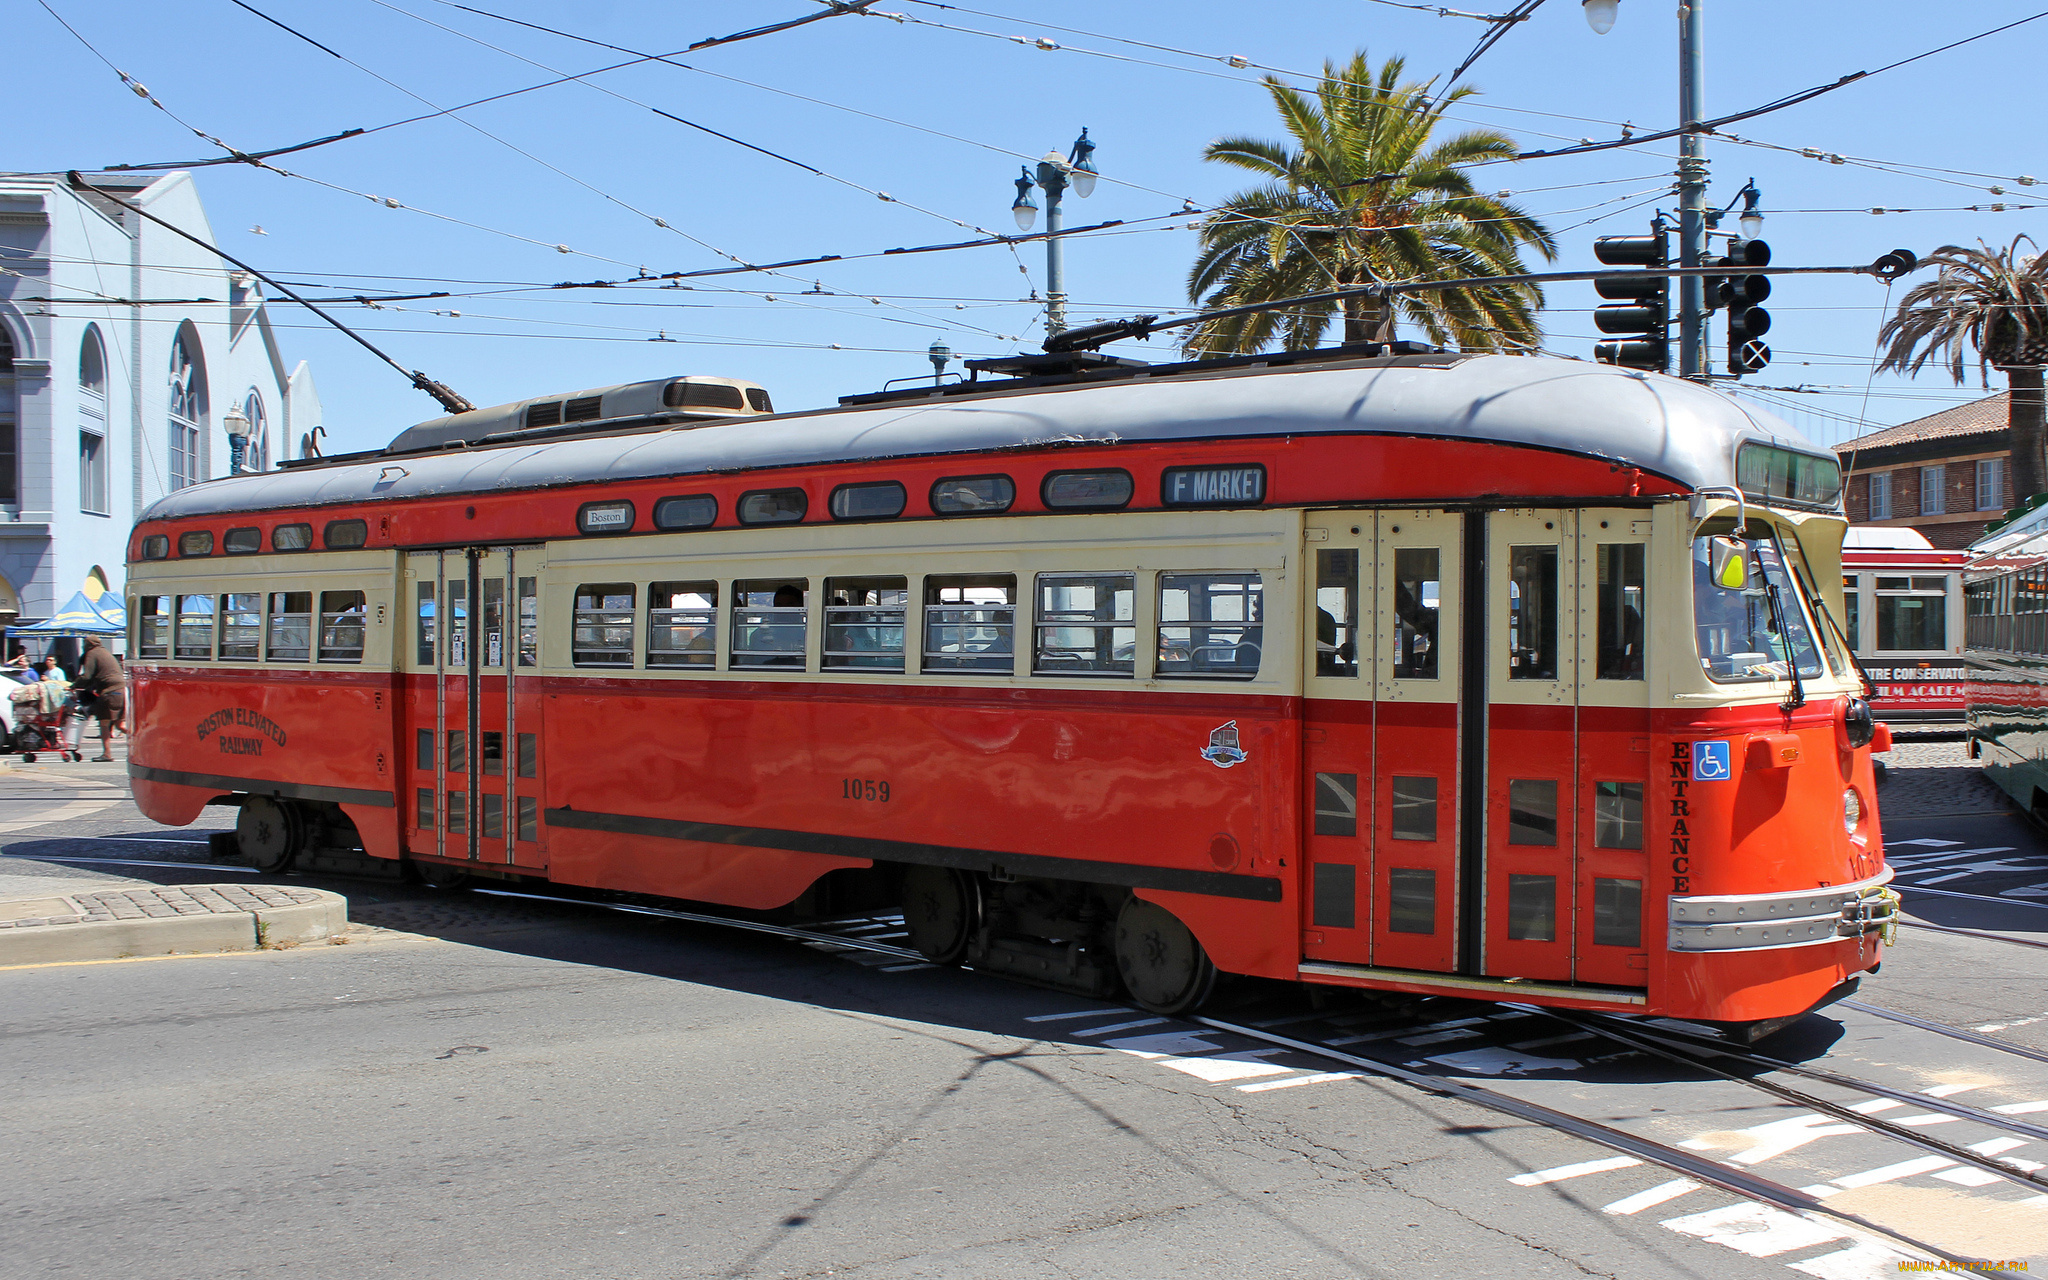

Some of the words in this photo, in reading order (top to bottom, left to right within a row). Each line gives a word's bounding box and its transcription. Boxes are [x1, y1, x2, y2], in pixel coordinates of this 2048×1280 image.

[1173, 472, 1187, 501] F
[1193, 469, 1262, 500] MARKET
[591, 512, 621, 523] Boston
[197, 708, 234, 741] BOSTON
[236, 708, 287, 747] ELEVATED
[219, 735, 263, 756] RAILWAY
[842, 778, 890, 802] 1059
[1670, 742, 1690, 893] ENTRANCE
